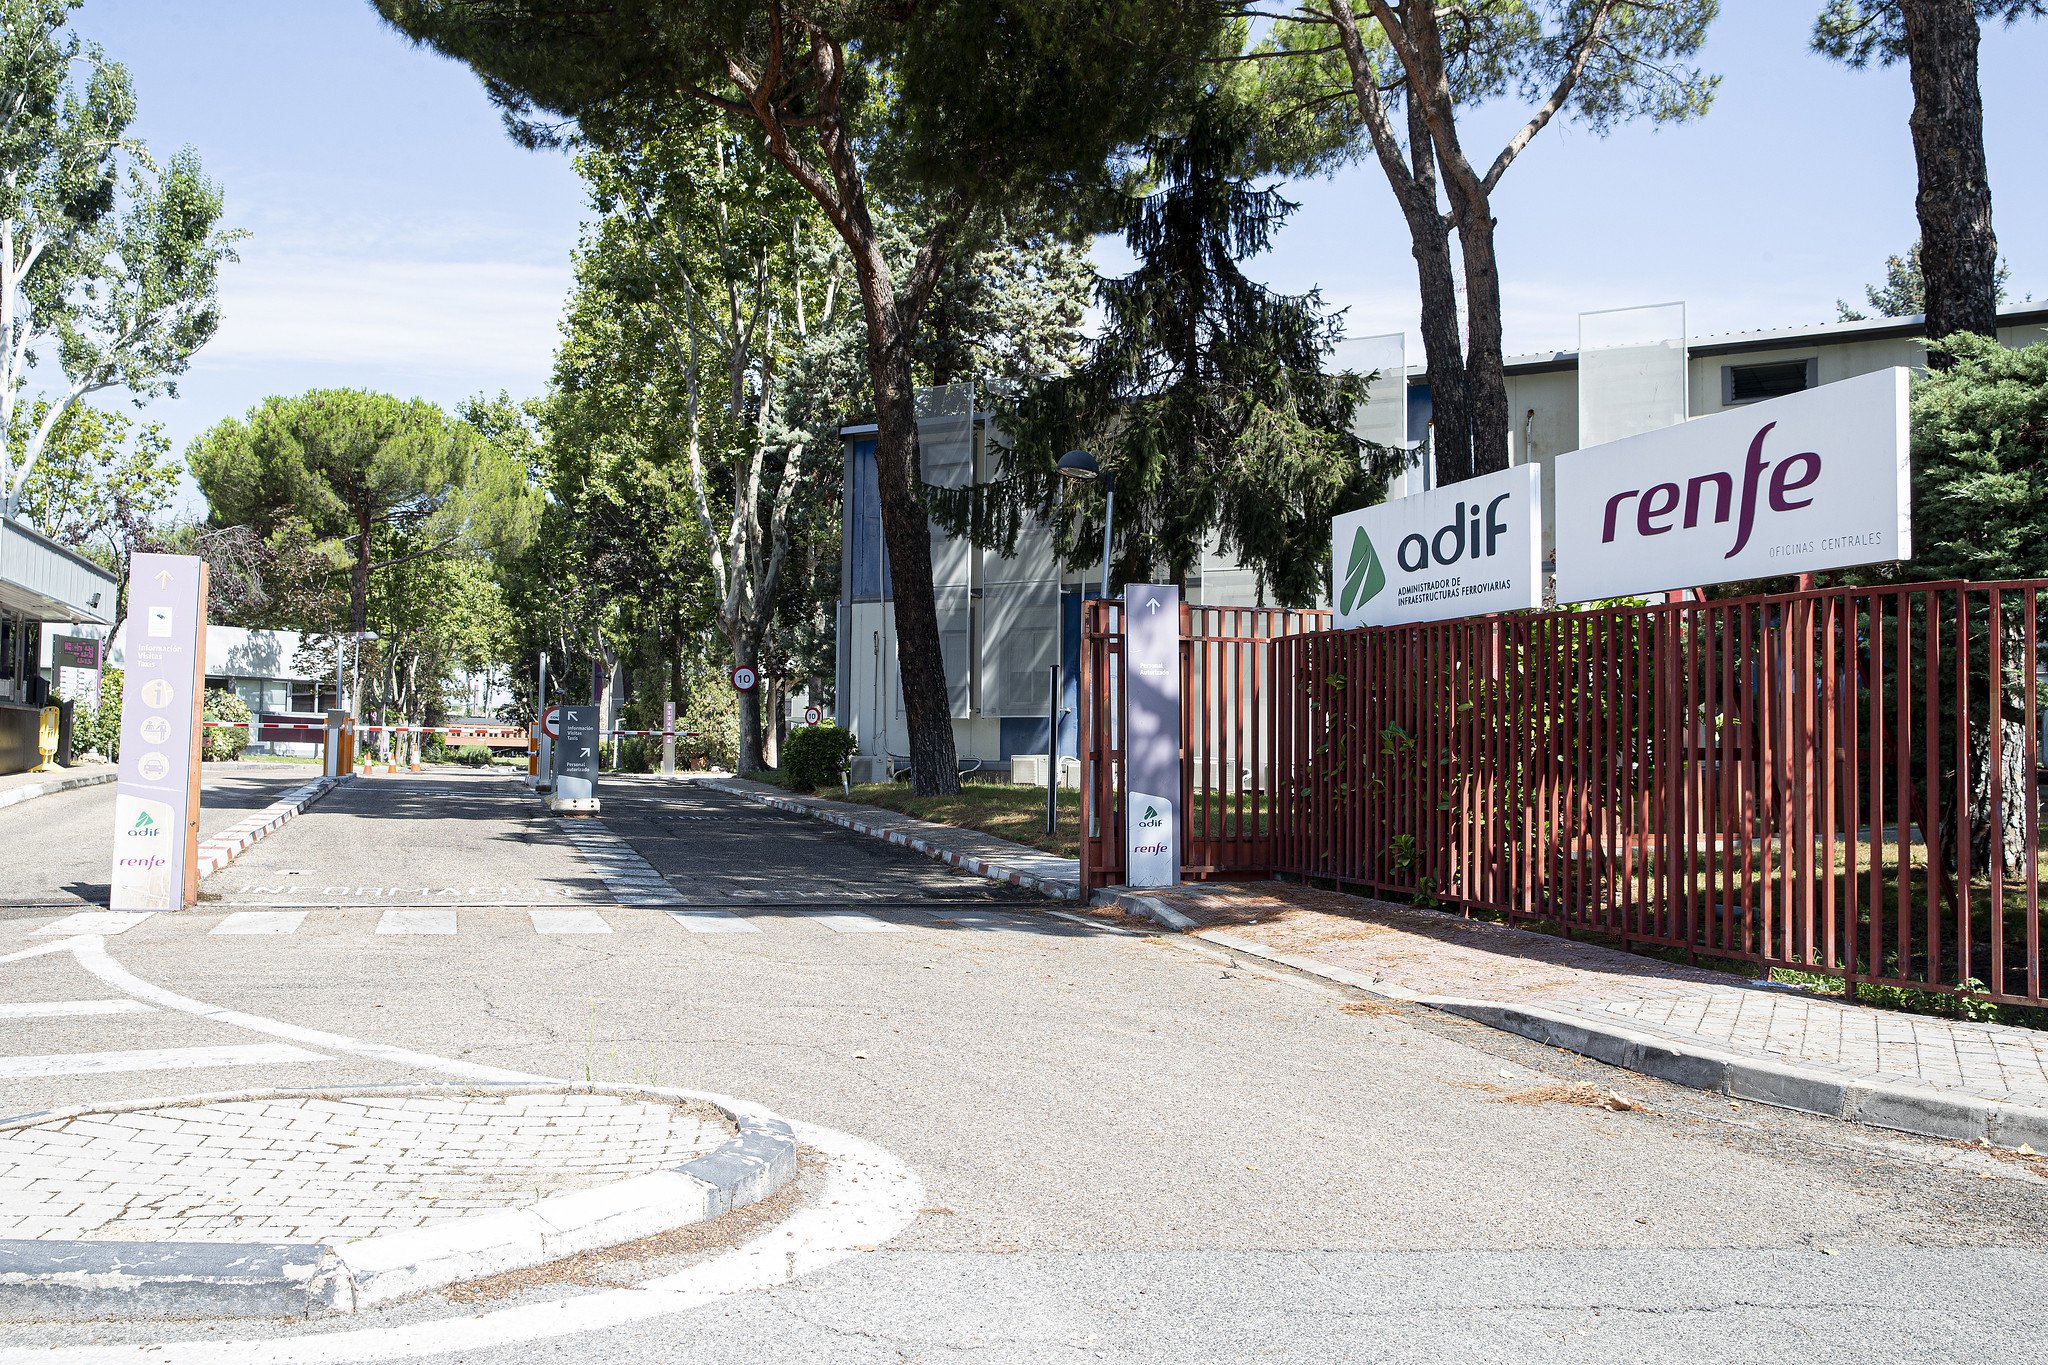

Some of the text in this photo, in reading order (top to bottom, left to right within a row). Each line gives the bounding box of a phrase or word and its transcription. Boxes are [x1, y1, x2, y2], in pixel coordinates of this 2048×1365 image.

[1602, 421, 1821, 559] renfe
[1397, 492, 1510, 573] adif
[1769, 532, 1882, 557] OFICINAS CENTRALES
[1397, 577, 1461, 597] ADMINISTRADOR DE
[1398, 579, 1511, 606] INFRAESTRUCTURAS FERROVIARIAS
[137, 652, 162, 660] Visitas
[138, 643, 183, 653] Información
[738, 674, 751, 684] 10
[1138, 819, 1163, 828] adif
[127, 827, 161, 837] adif
[1134, 841, 1168, 857] renfe
[119, 854, 166, 871] renfe
